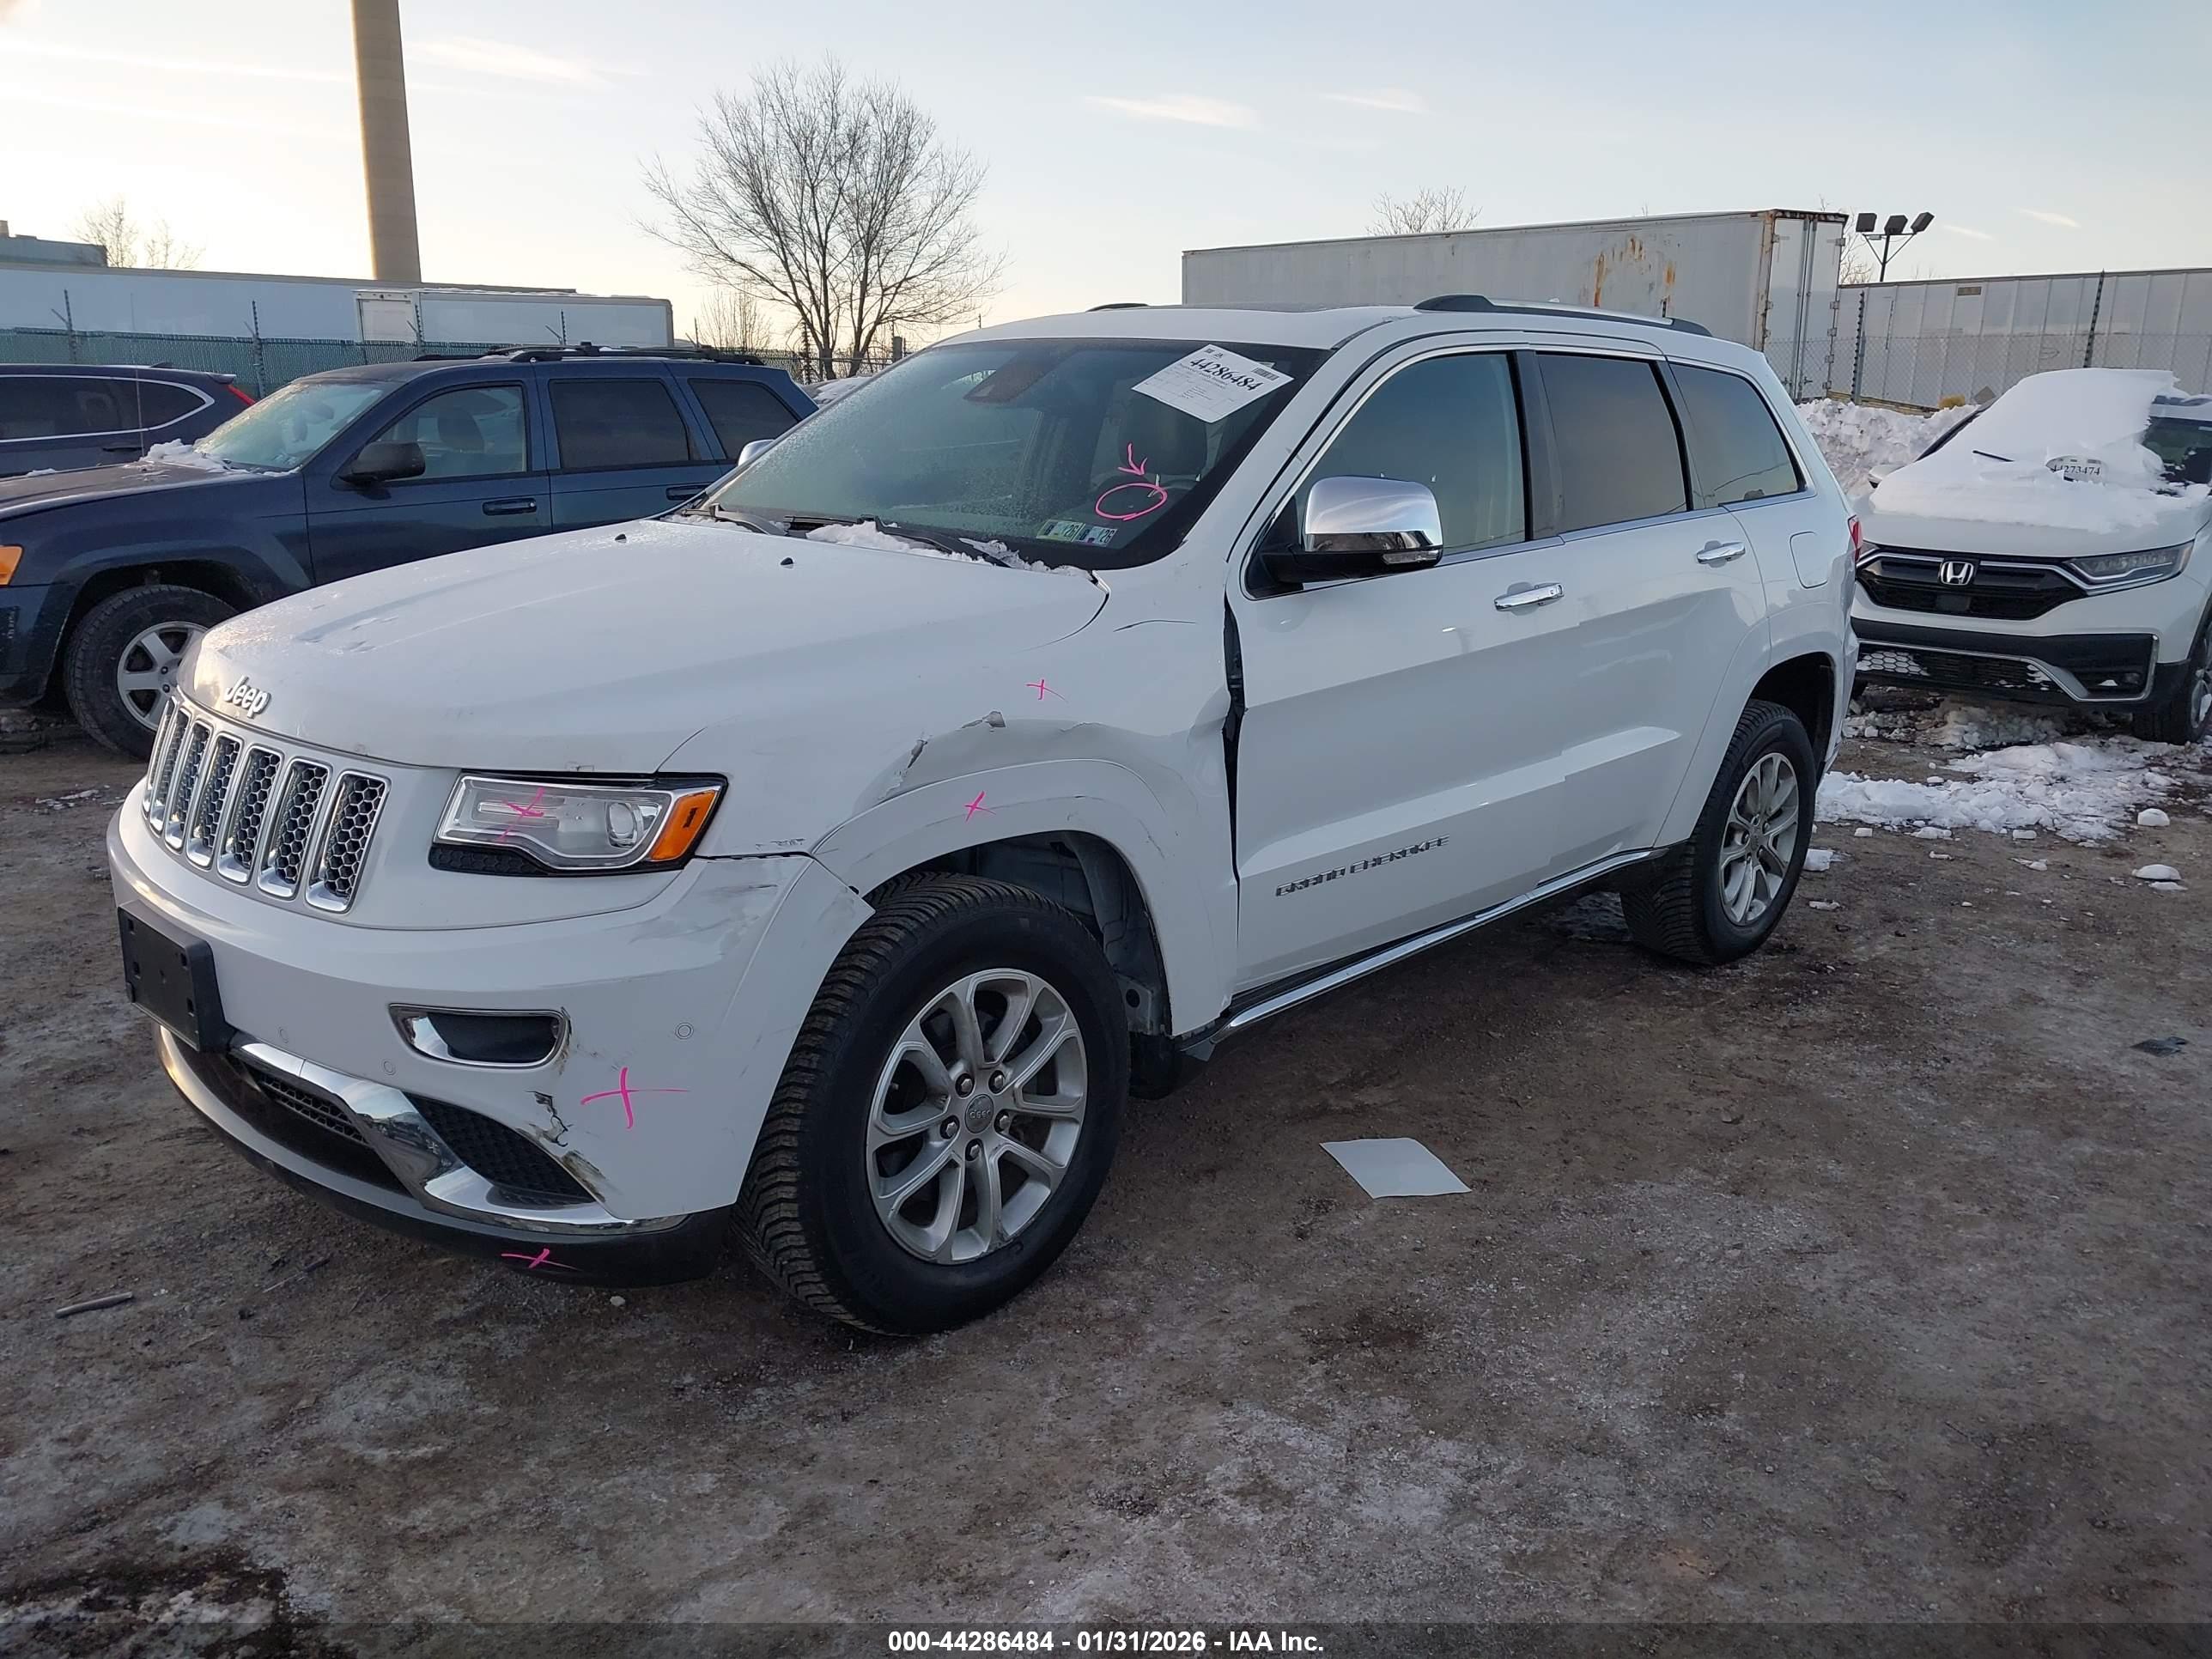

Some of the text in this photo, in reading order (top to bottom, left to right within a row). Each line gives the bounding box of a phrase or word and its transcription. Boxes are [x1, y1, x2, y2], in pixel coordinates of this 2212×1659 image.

[1189, 358, 1264, 391] 44286484
[223, 675, 271, 719] Jeep
[1276, 834, 1449, 896] GRAND CHEROKEE
